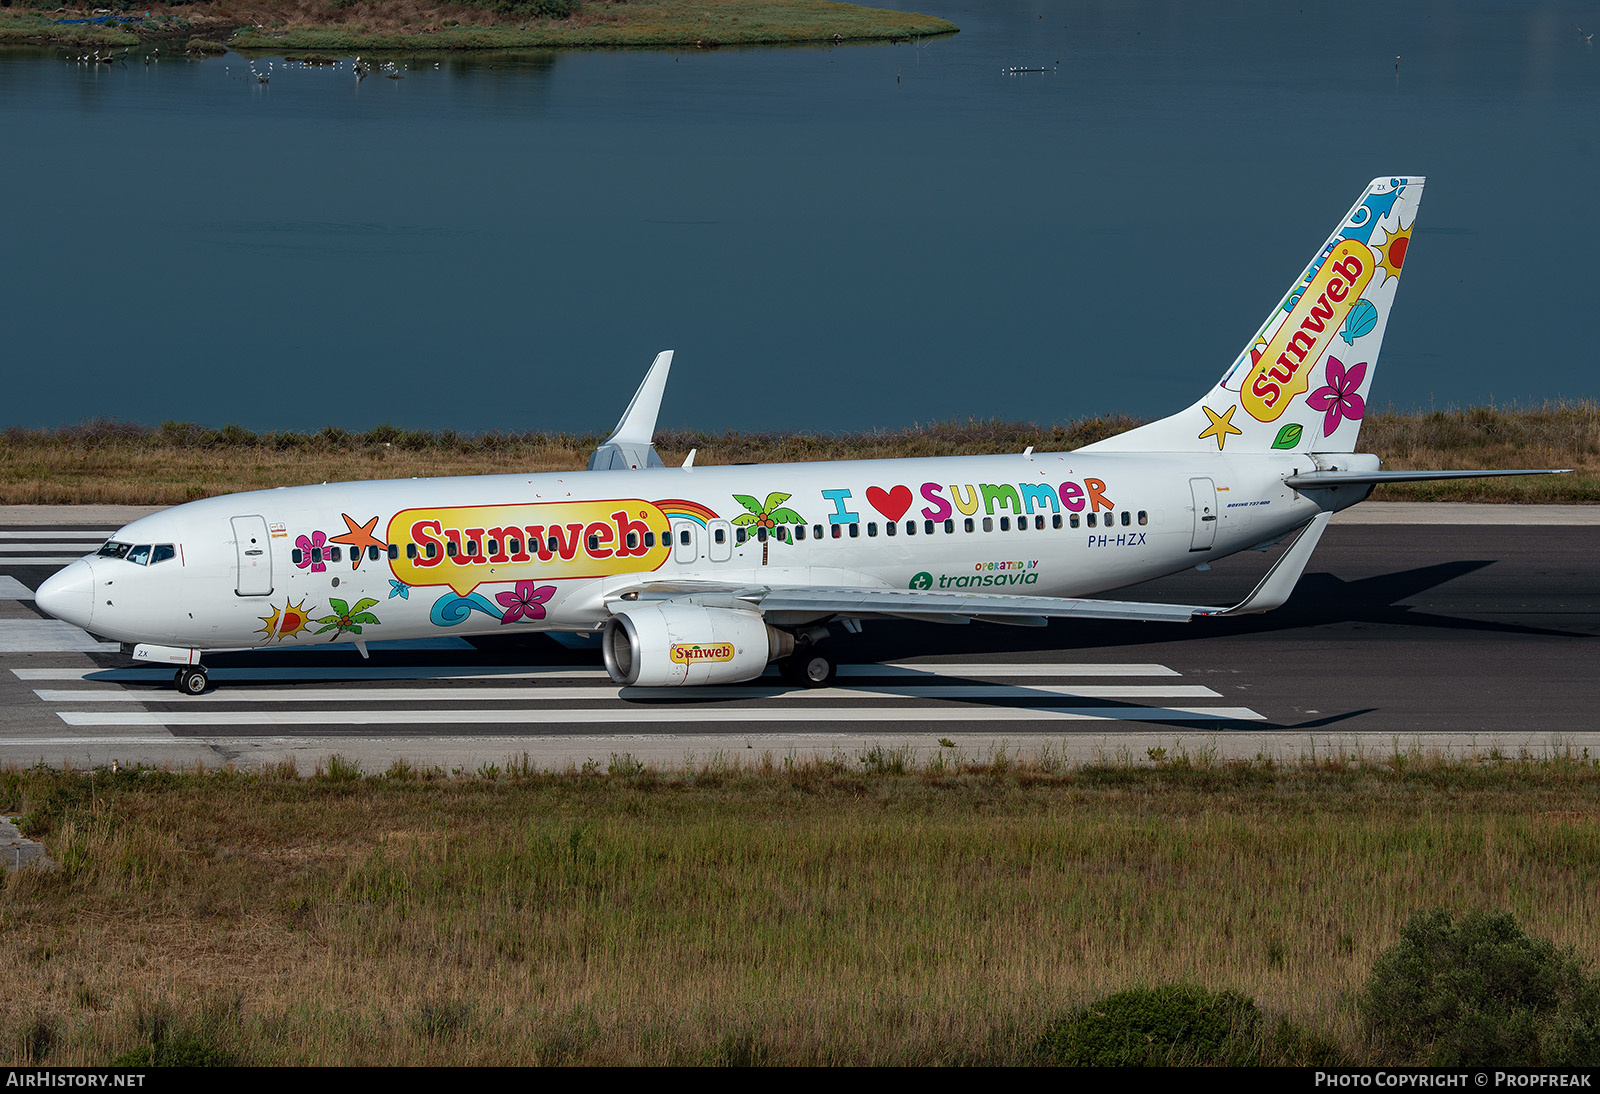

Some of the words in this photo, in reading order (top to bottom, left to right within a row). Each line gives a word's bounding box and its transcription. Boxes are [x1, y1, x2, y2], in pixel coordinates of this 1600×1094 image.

[1252, 255, 1364, 408] Sunweb
[820, 488, 861, 525] I
[410, 510, 652, 568] Sunweb
[1088, 532, 1147, 548] PH-HZX
[1027, 560, 1039, 569] BY
[939, 569, 1039, 588] transavia
[675, 646, 731, 659] Sunweb
